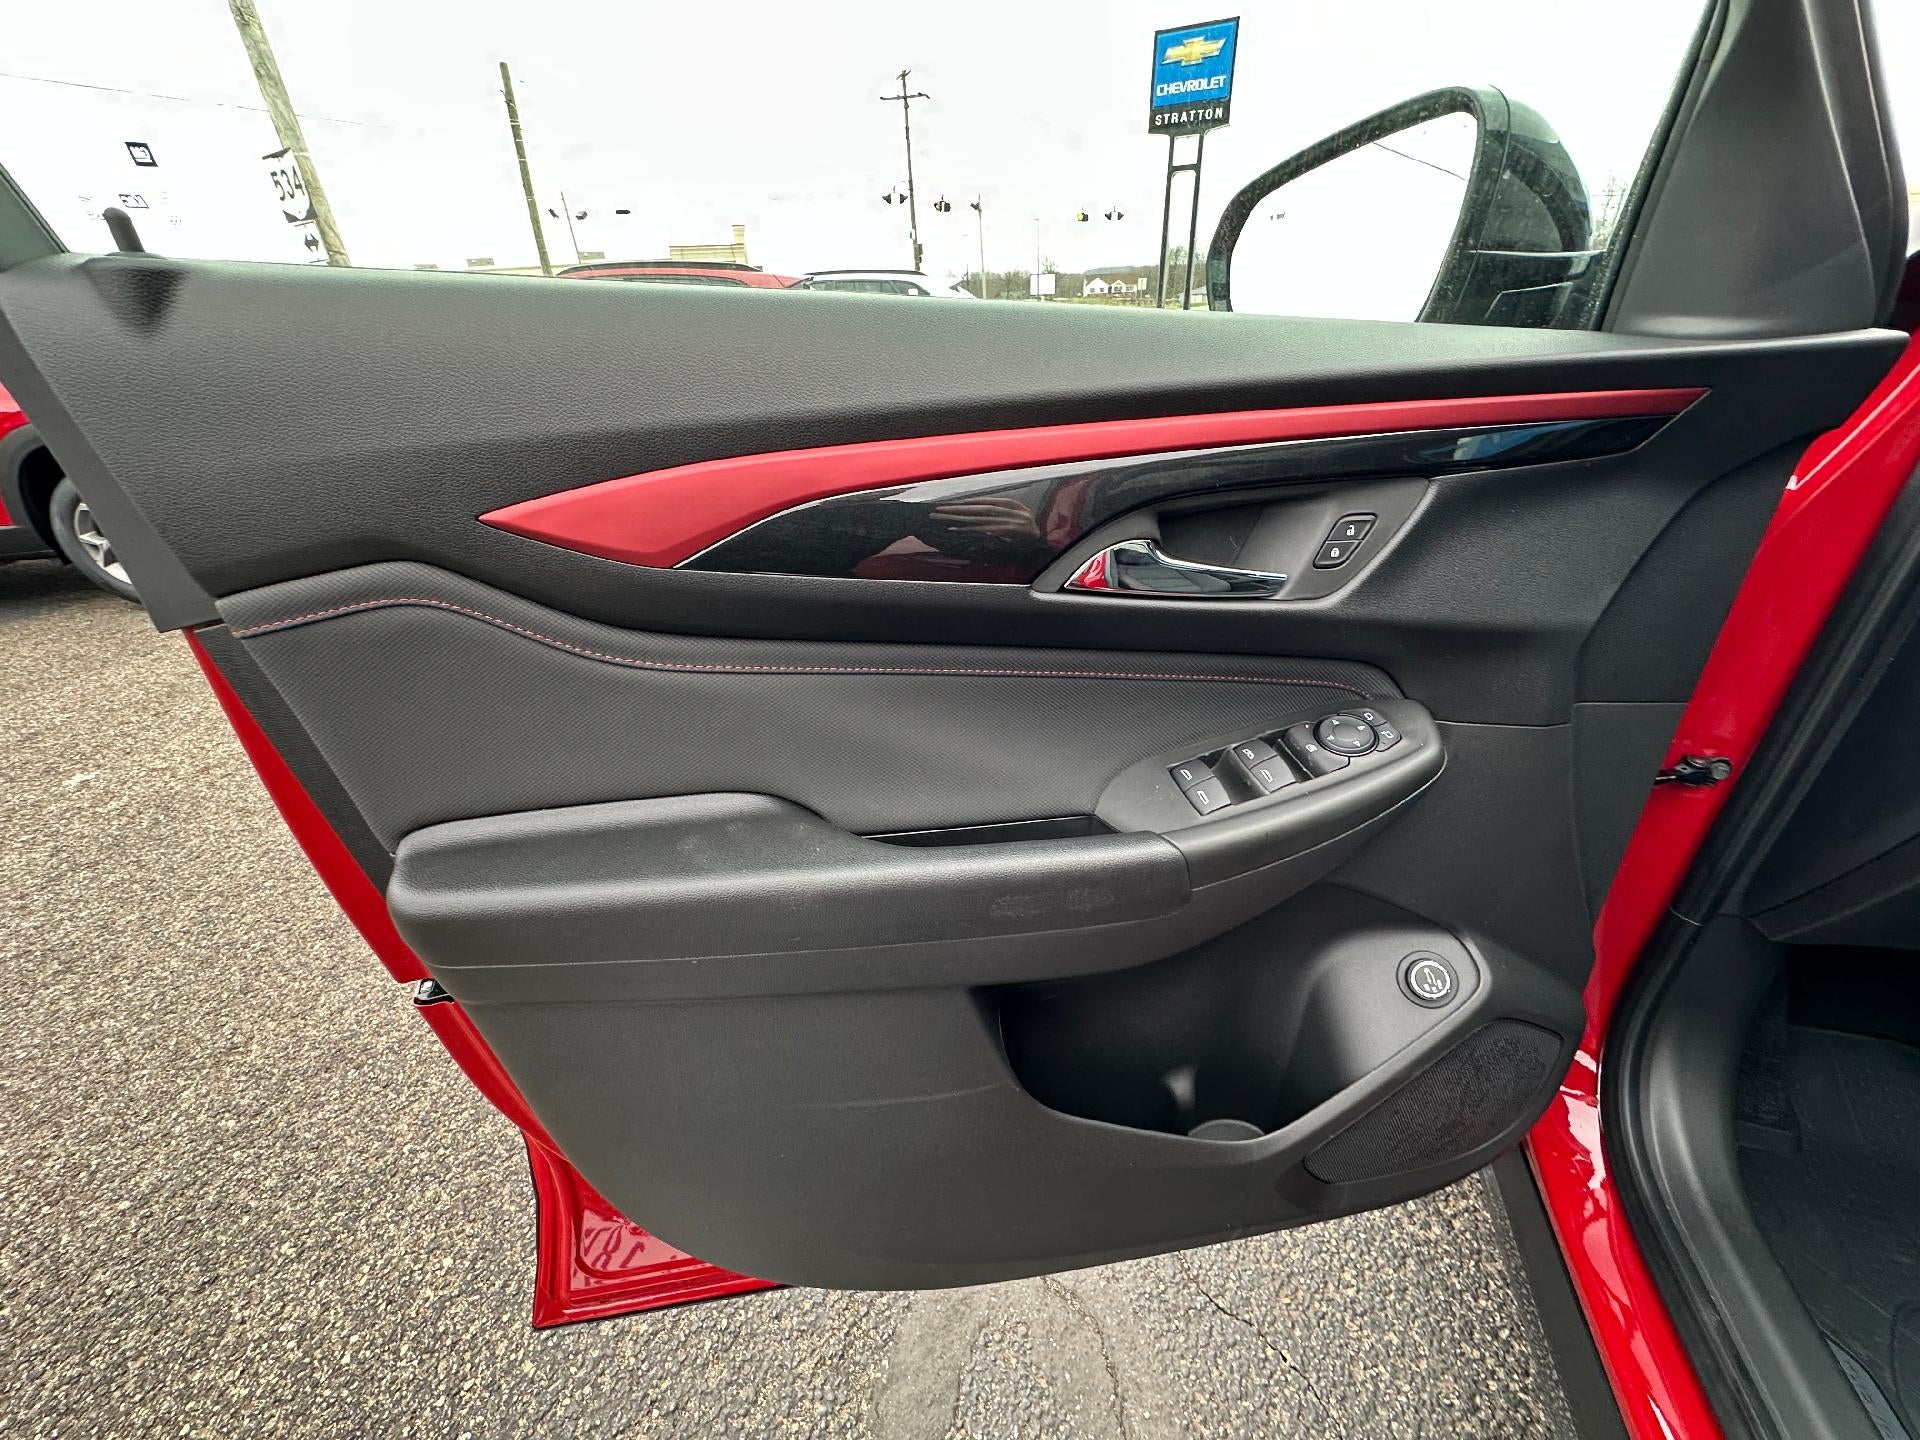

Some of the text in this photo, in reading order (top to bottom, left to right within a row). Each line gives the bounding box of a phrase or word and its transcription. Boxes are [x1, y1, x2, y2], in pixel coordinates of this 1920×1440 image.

[1156, 75, 1227, 97] CHEVROLET
[1155, 107, 1223, 126] STRATTON
[270, 165, 305, 201] 534
